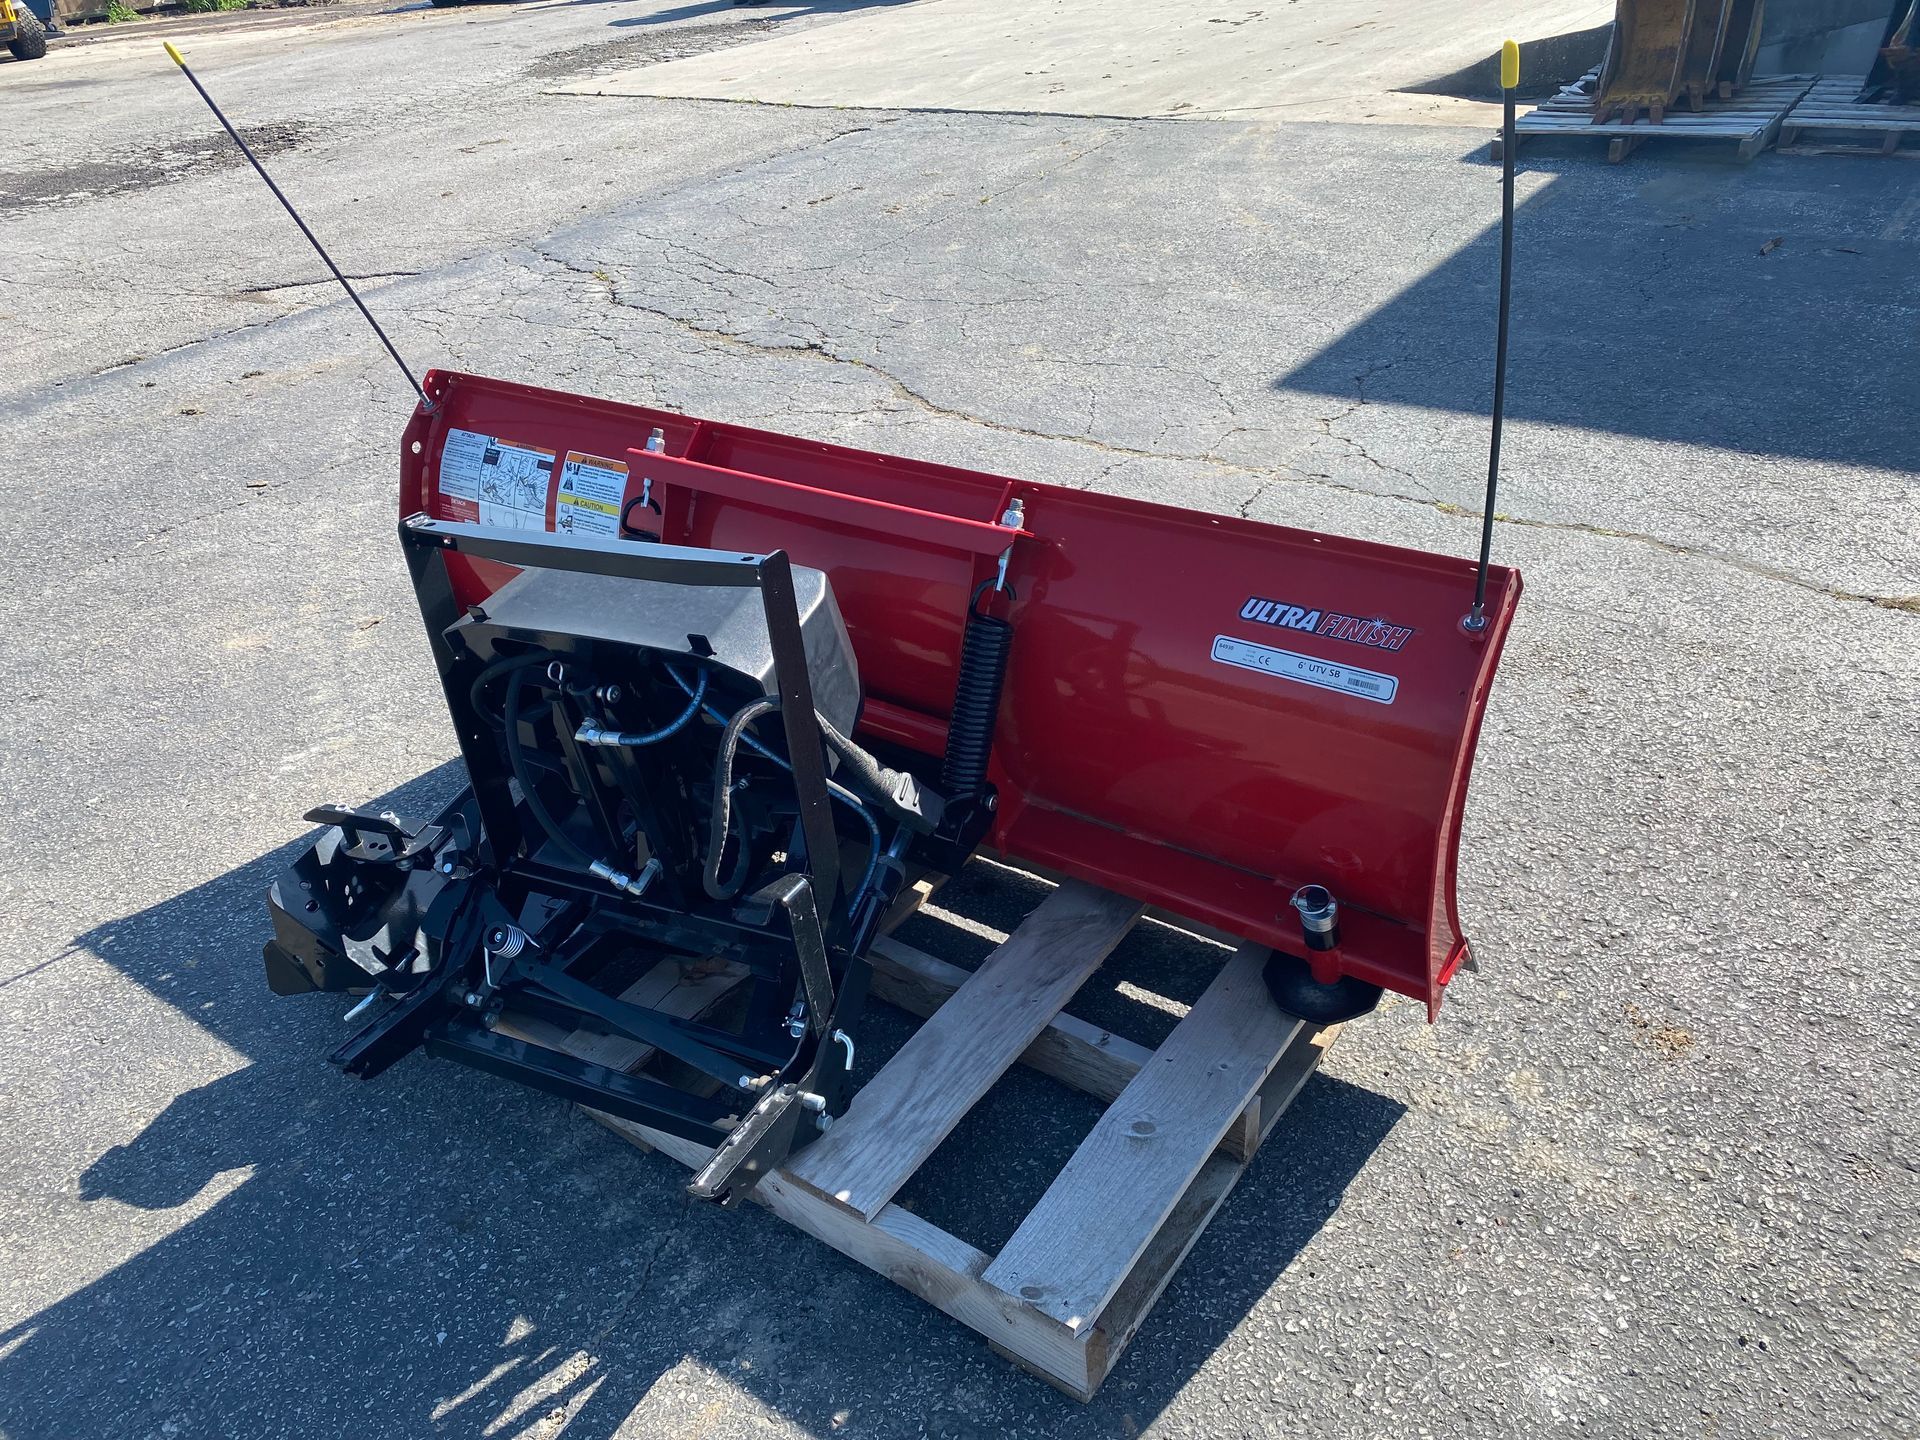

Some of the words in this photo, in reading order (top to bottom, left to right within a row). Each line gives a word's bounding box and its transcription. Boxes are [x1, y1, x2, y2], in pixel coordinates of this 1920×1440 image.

[579, 500, 604, 511] CAUTION
[1240, 598, 1320, 632] ULTRA
[1316, 613, 1412, 651] FINISH
[1297, 661, 1307, 670] 6'
[1308, 663, 1327, 675] UTV
[1328, 668, 1341, 678] SB
